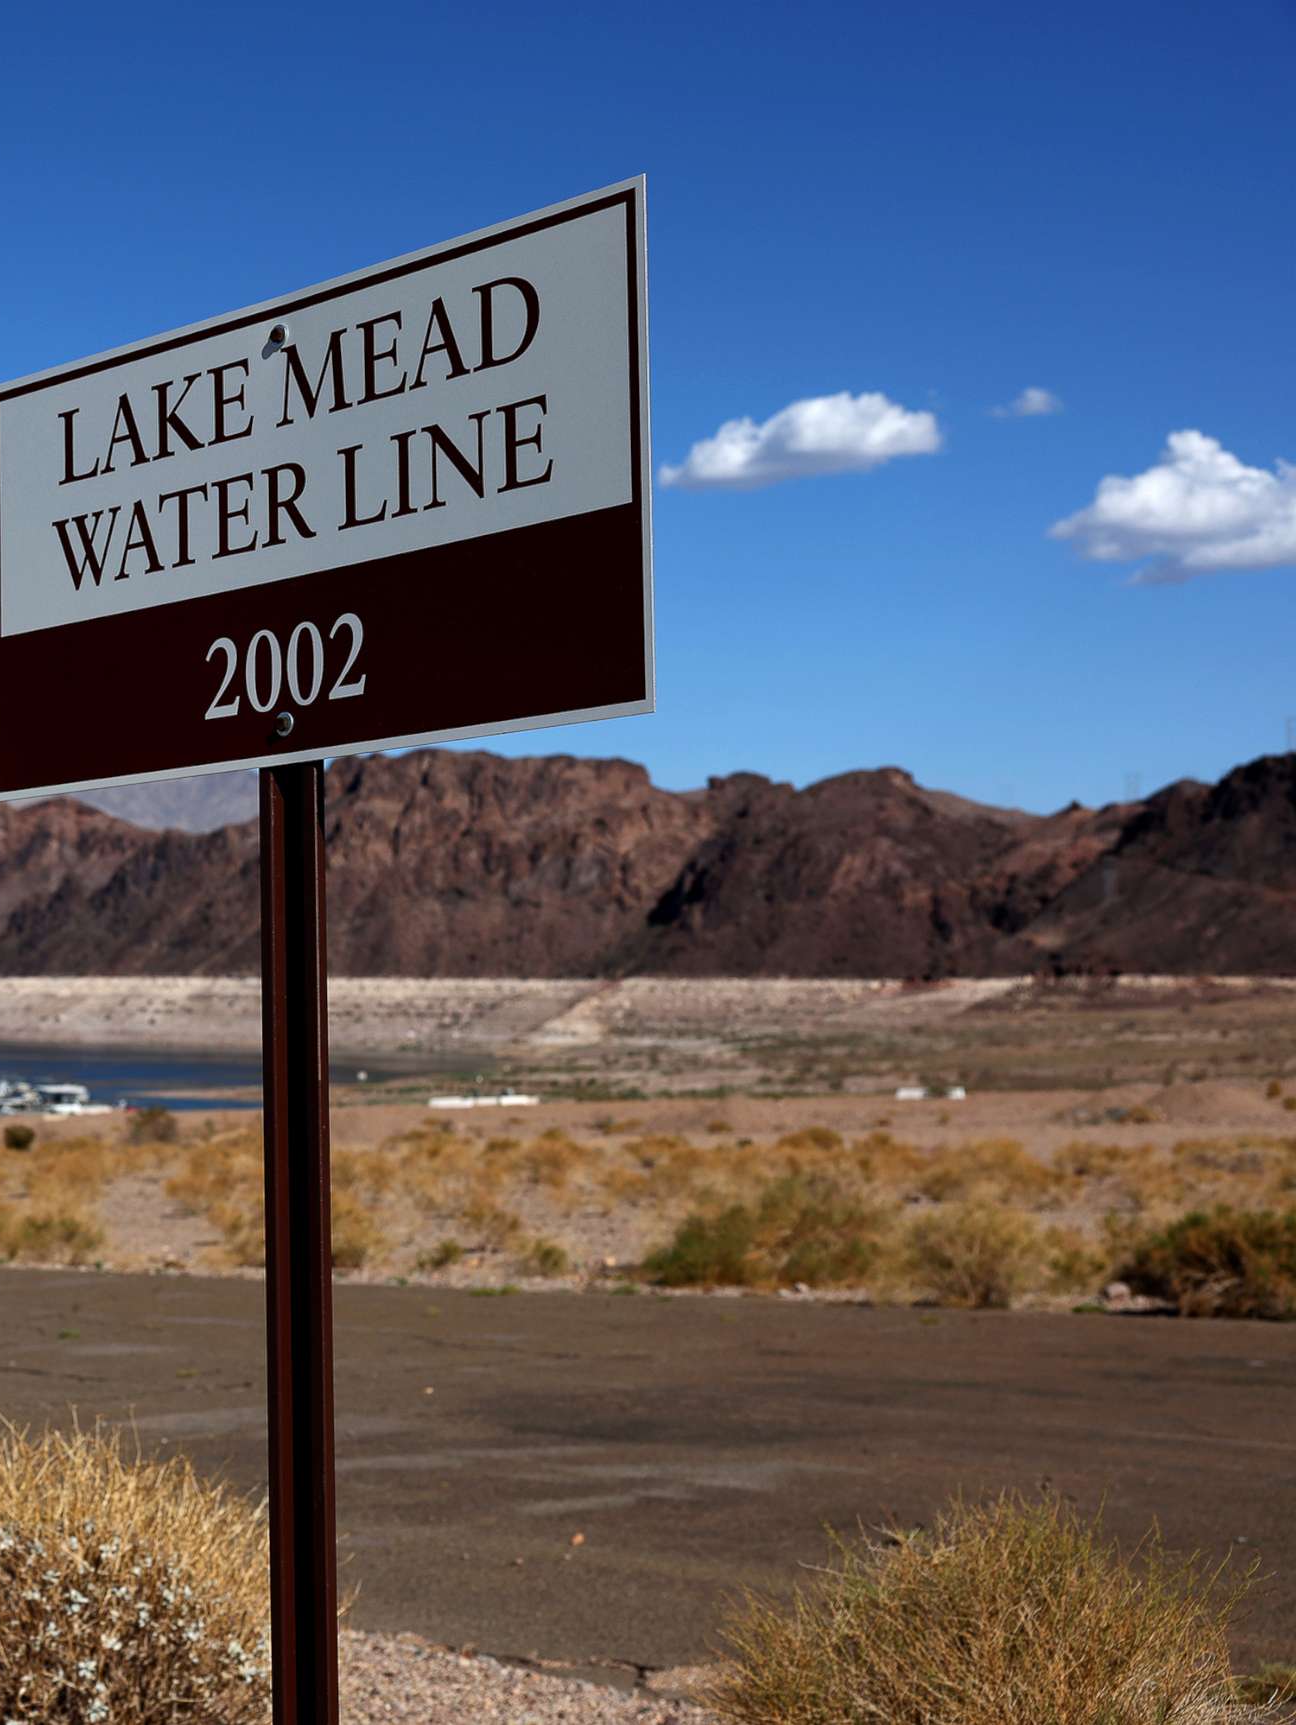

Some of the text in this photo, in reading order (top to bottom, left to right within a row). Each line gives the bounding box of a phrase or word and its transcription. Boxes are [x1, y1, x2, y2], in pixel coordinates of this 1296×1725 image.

[57, 276, 540, 486] LAKE MEAD
[52, 394, 554, 592] WATER LINE
[204, 612, 367, 721] 2002
